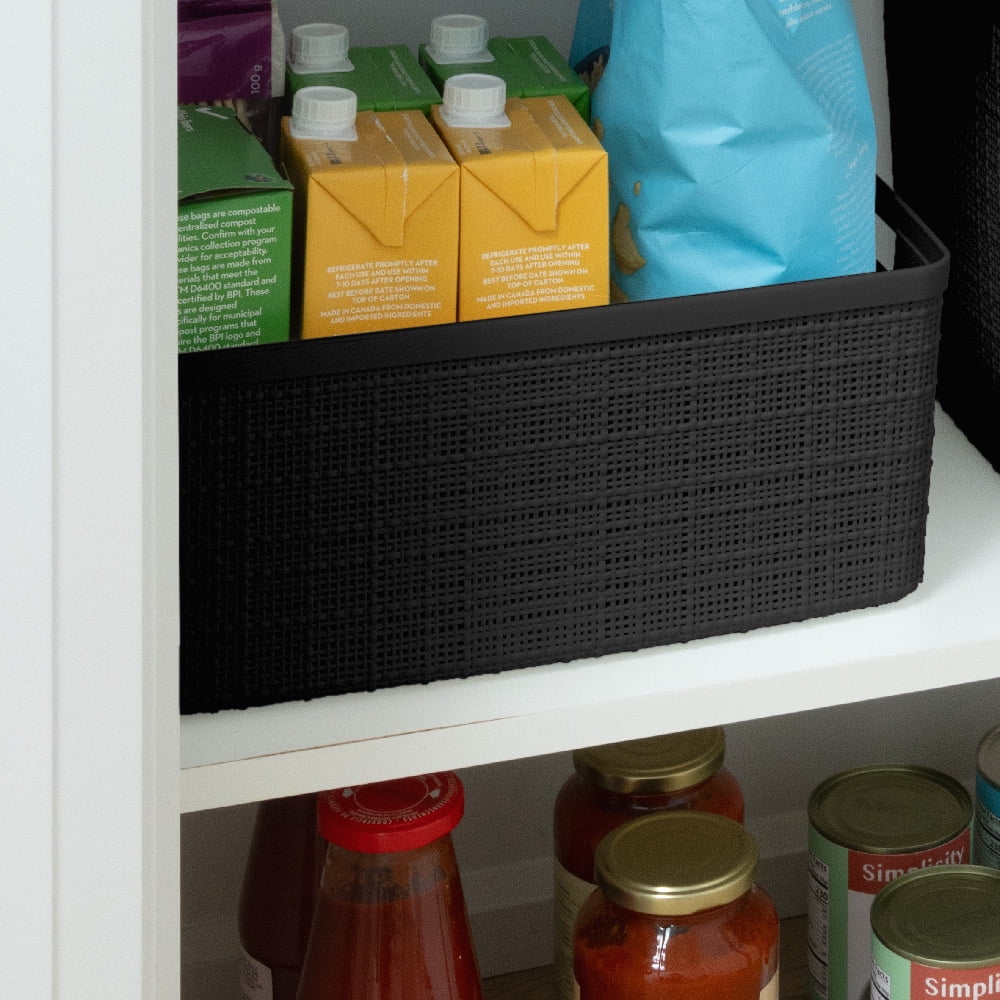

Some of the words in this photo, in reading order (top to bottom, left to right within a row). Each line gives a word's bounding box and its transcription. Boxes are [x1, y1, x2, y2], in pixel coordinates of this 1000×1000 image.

[254, 64, 263, 72] g
[251, 72, 261, 95] 100
[191, 212, 211, 221] bags
[228, 203, 281, 216] compostable
[220, 218, 256, 228] compost
[202, 230, 236, 240] Confirm
[238, 227, 255, 235] with
[257, 226, 275, 236] your
[201, 240, 240, 250] collection
[242, 237, 277, 247] program
[201, 252, 212, 261] for
[481, 248, 527, 259] REFRIGERATE
[528, 244, 566, 253] PROMPTLY
[568, 243, 590, 251] AFTER
[190, 264, 210, 273] bags
[227, 259, 250, 268] made
[252, 257, 272, 265] from
[490, 258, 509, 266] EACH
[555, 251, 581, 259] WITHIN
[327, 262, 374, 273] REFRIGERATE
[375, 260, 413, 269] PROMPTLY
[506, 264, 523, 272] DAYS
[202, 272, 219, 281] that
[221, 271, 242, 279] meet
[244, 268, 258, 276] the
[351, 279, 369, 287] DAYS
[395, 275, 428, 283] OPENING
[483, 277, 500, 285] BEST
[501, 274, 527, 283] BEFORE
[529, 271, 547, 279] DATE
[178, 285, 188, 293] M
[191, 282, 222, 293] D6400
[223, 276, 259, 289] standard
[261, 274, 276, 284] and
[534, 278, 564, 286] CARTON
[215, 292, 224, 301] by
[227, 290, 243, 299] BPI.
[246, 287, 270, 297] These
[328, 291, 344, 299] BEST
[346, 288, 373, 297] BEFORE
[375, 286, 393, 294] DATE
[380, 294, 410, 302] CARTON
[476, 295, 497, 303] MADE
[506, 290, 535, 299] CANADA
[536, 287, 557, 295] FROM
[557, 285, 595, 293] DOMESTIC
[199, 300, 237, 313] designed
[486, 302, 501, 310] AND
[502, 297, 537, 307] IMPORTED
[539, 293, 585, 302] INGREDIENTS
[209, 313, 221, 321] for
[223, 307, 262, 319] municipal
[321, 309, 341, 317] MADE
[404, 302, 442, 310] DOMESTIC
[346, 313, 382, 322] IMPORTED
[384, 310, 432, 318] INGREDIENTS
[199, 323, 239, 334] programs
[240, 319, 257, 327] that
[193, 336, 207, 344] the
[209, 333, 223, 342] BPI
[225, 332, 244, 342] logo
[245, 328, 261, 336] and
